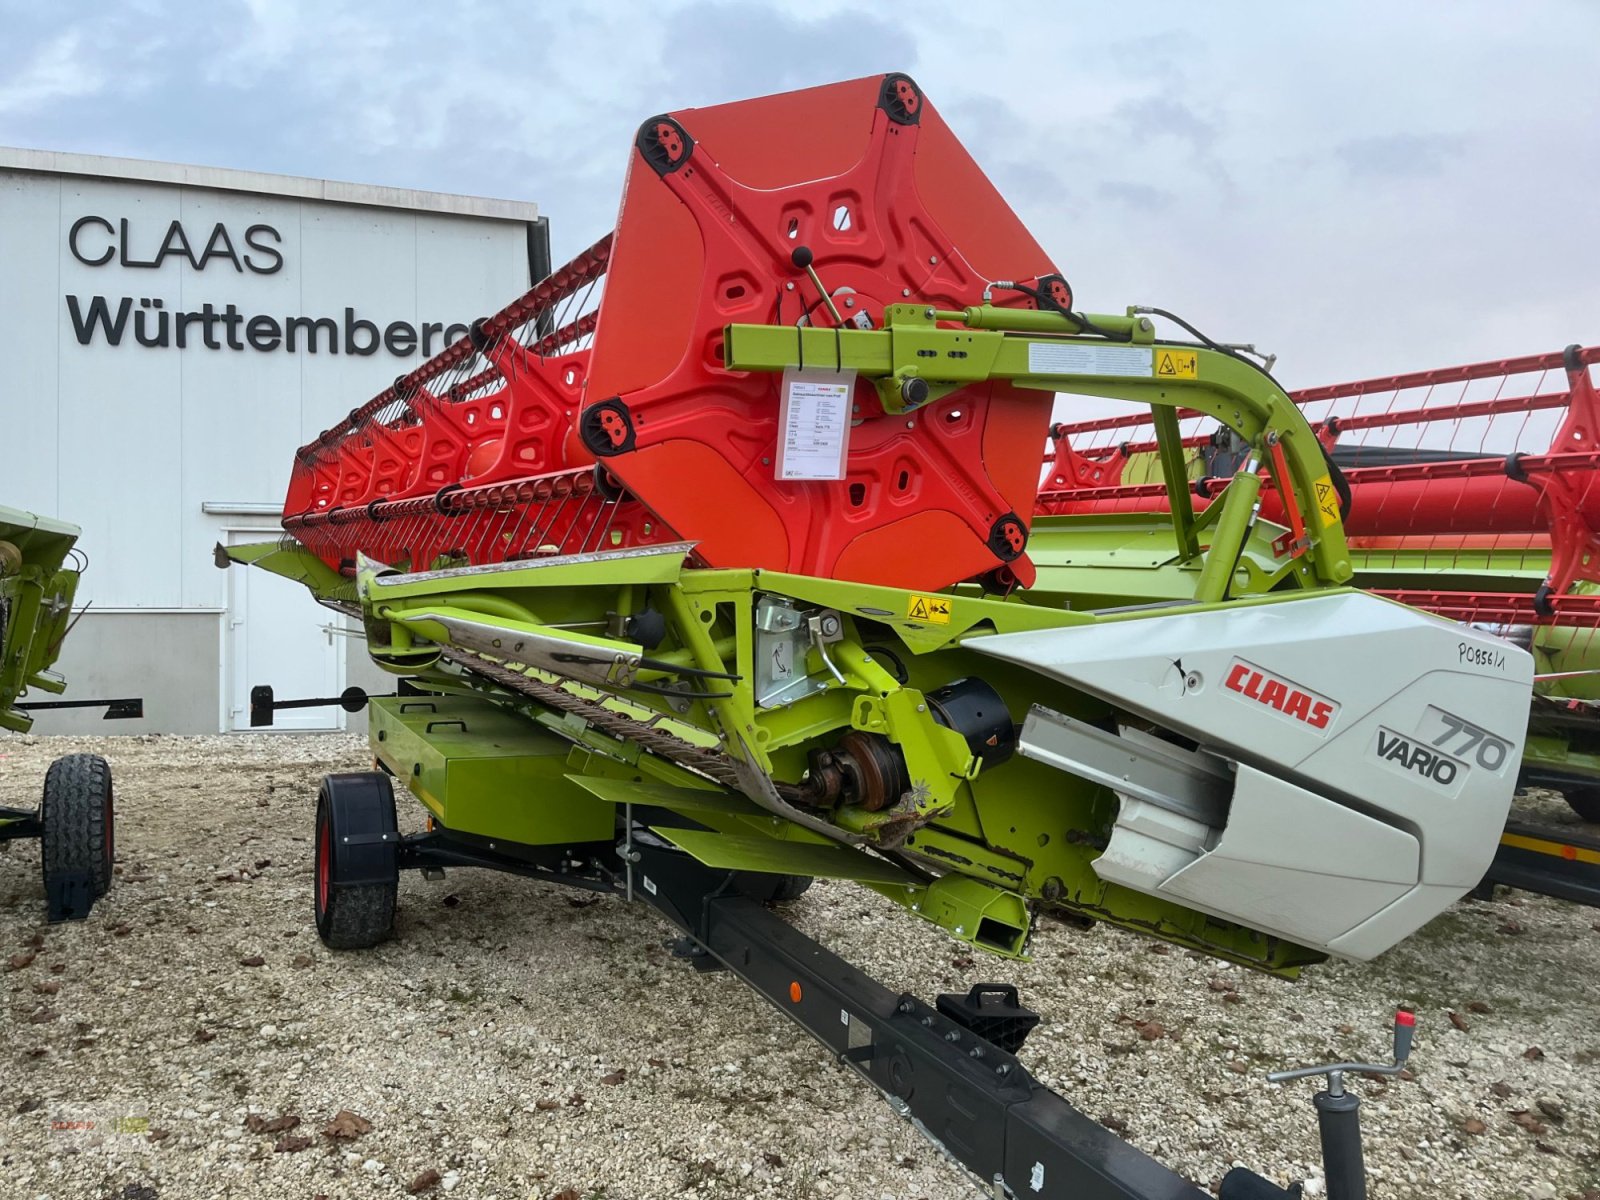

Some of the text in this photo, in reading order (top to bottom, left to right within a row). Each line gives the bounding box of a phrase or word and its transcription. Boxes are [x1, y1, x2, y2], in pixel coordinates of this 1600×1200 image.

[69, 215, 283, 275] CLAAS
[1224, 663, 1334, 730] CLAAS
[1376, 730, 1458, 786] VARIO
[1431, 714, 1508, 772] 770
